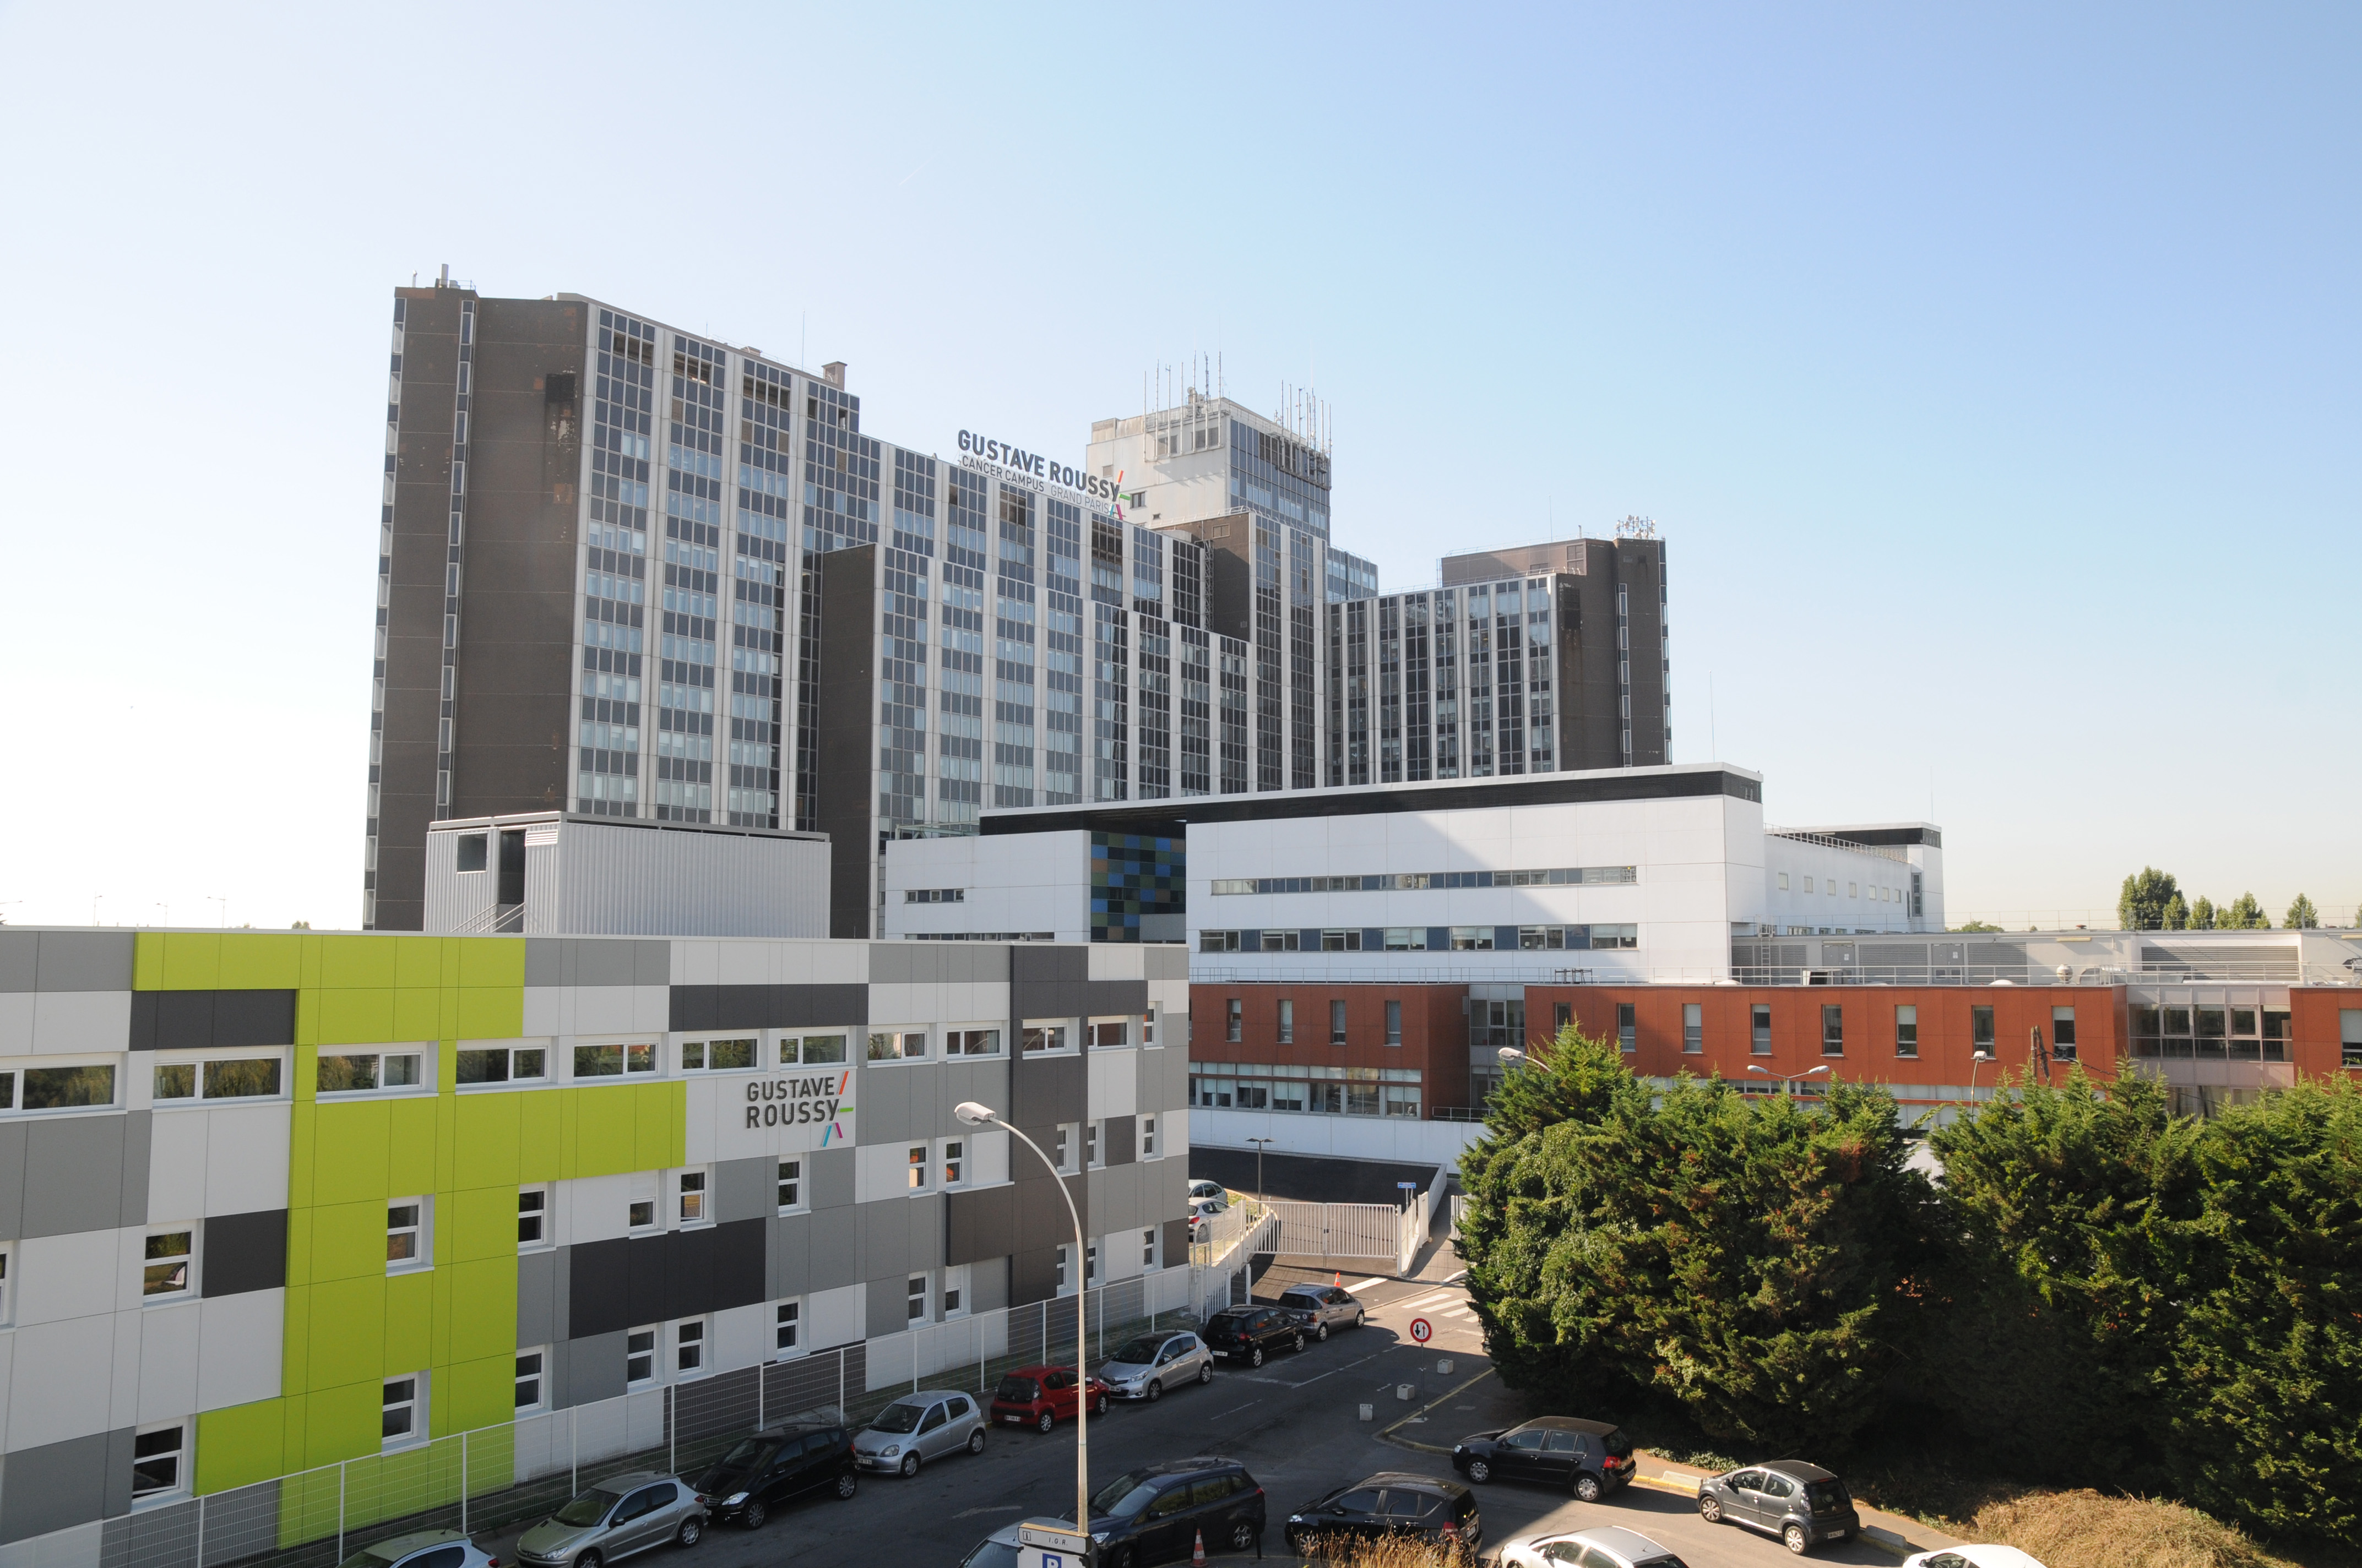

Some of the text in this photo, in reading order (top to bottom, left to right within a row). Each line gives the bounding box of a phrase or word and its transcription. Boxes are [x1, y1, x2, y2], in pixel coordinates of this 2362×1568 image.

[958, 429, 1120, 502] GUSTAVE ROUSSY
[962, 455, 1109, 514] CANCER CAMPUS GRAND PARIS
[747, 1077, 834, 1102] GUSTAVE
[747, 1099, 839, 1129] ROUSSY
[1049, 1537, 1068, 1546] I.G.R.
